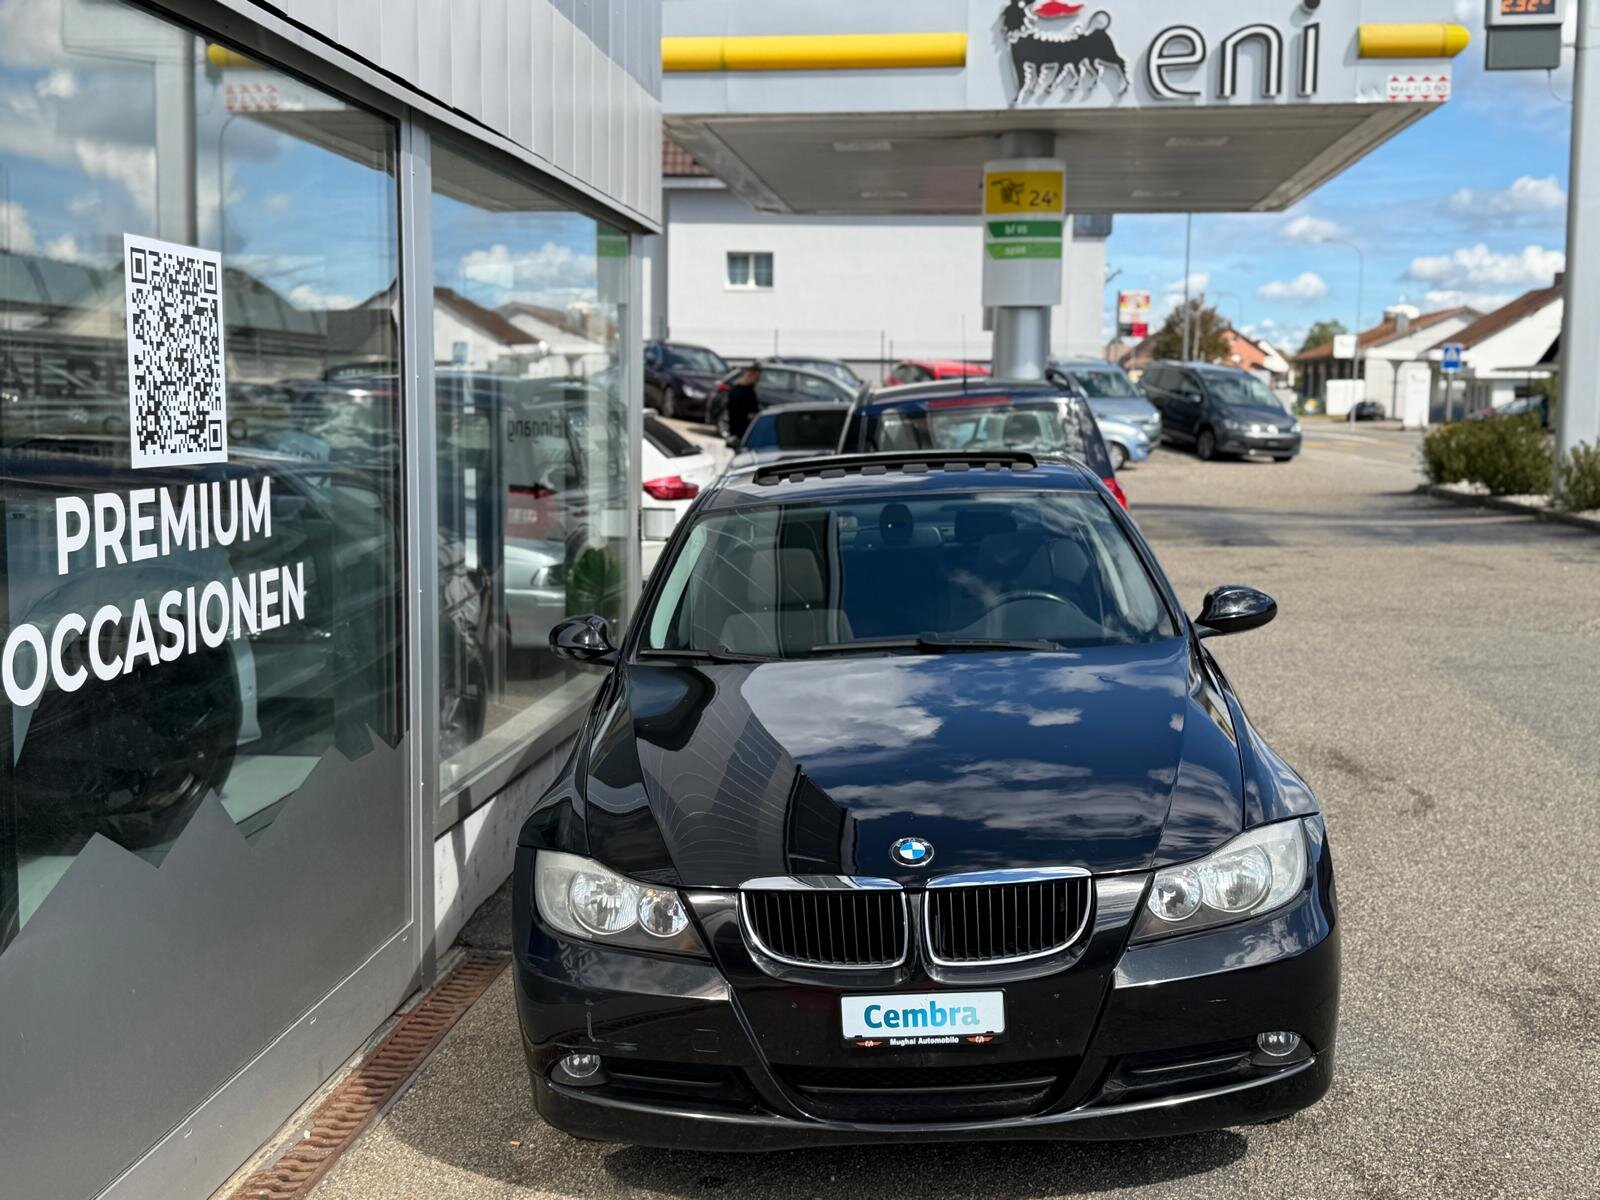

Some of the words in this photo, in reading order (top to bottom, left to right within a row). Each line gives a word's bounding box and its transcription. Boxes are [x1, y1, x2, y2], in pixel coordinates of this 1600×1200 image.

[1146, 0, 1320, 97] eni
[55, 475, 272, 575] PREMIUM
[2, 562, 305, 706] OCCASIONEN
[864, 1001, 980, 1029] Cembra
[889, 1037, 917, 1047] Mughal
